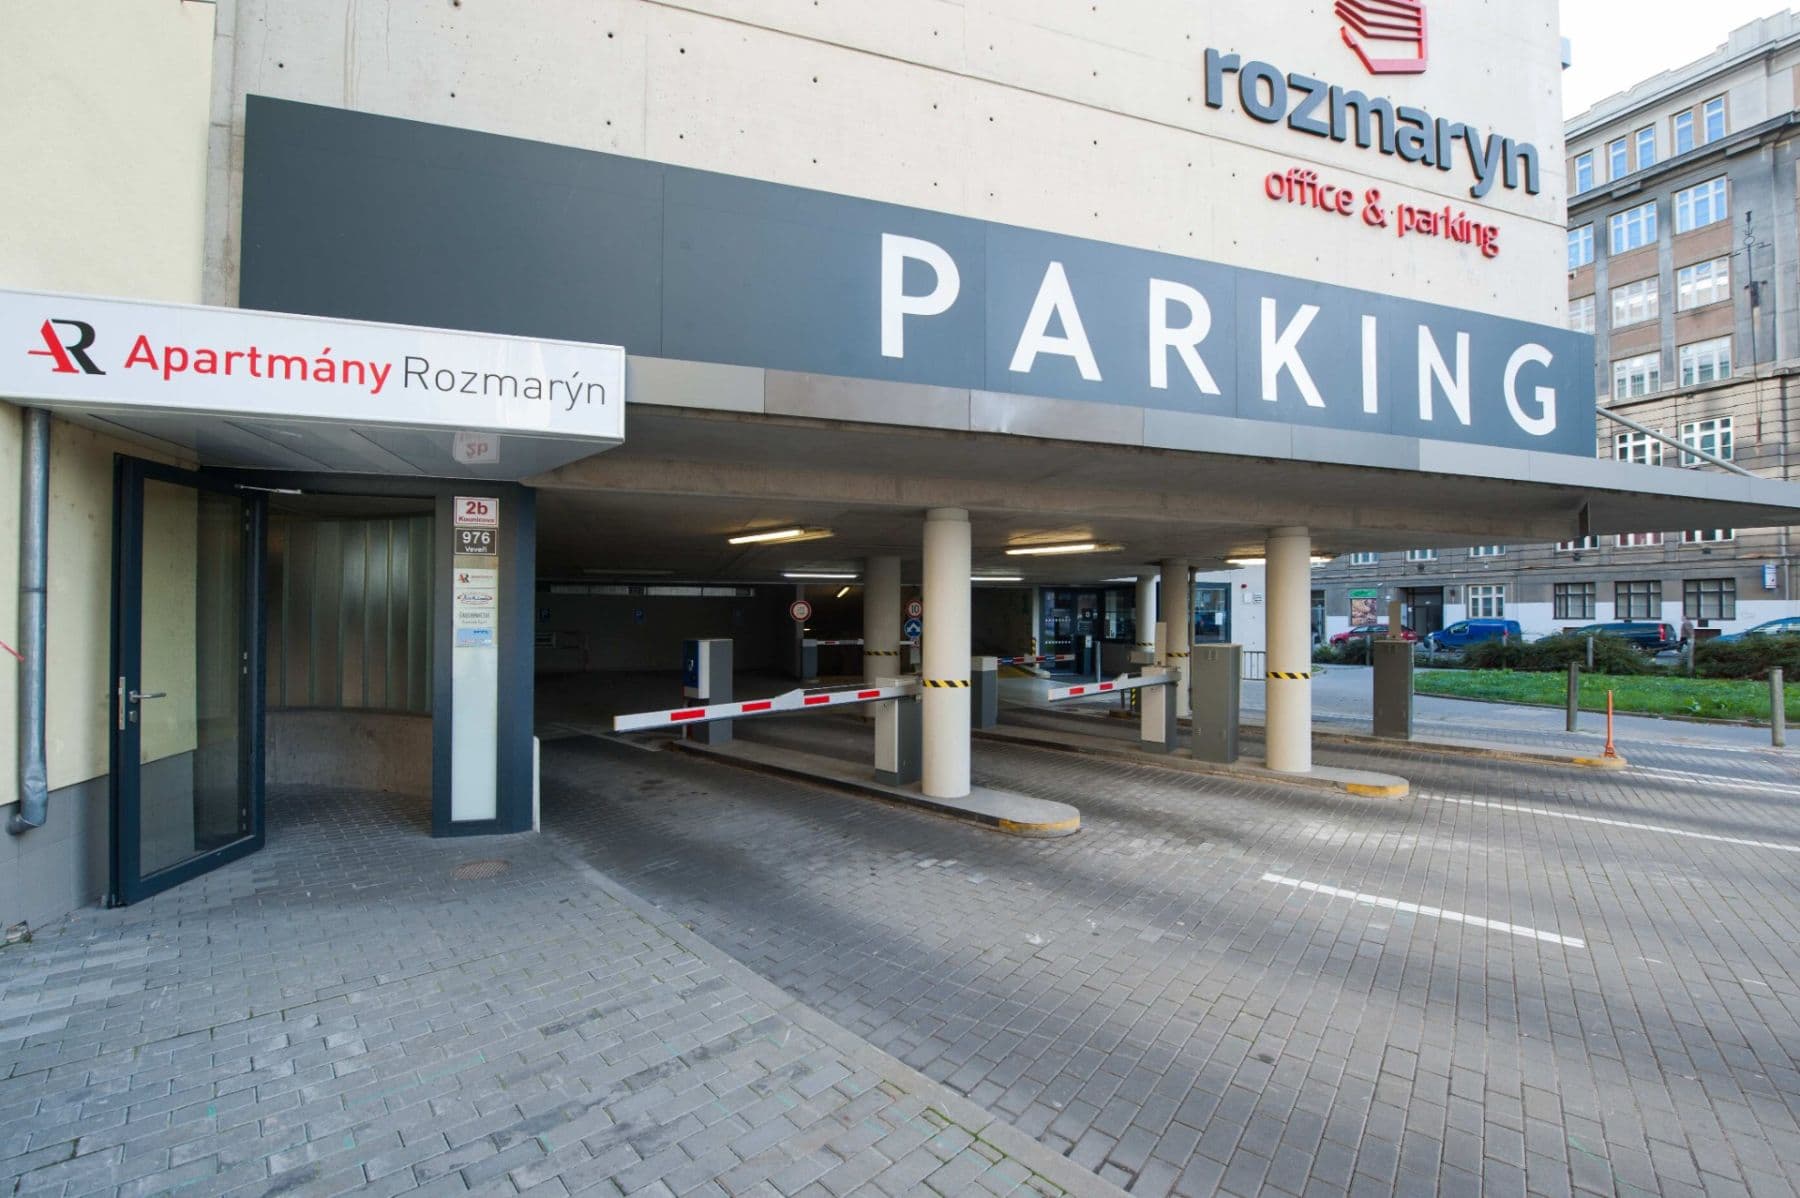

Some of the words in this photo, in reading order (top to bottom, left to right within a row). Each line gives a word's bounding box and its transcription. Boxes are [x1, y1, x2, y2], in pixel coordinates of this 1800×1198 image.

[1204, 47, 1540, 198] rozmaryn
[1264, 168, 1354, 216] office
[1361, 187, 1387, 228] &
[1397, 203, 1500, 258] parking
[124, 334, 392, 395] Apartmány
[404, 356, 607, 413] Rozmarýn
[881, 233, 1557, 437] PARKING
[462, 531, 491, 544] 976
[466, 501, 488, 515] 2b
[911, 604, 920, 613] 10
